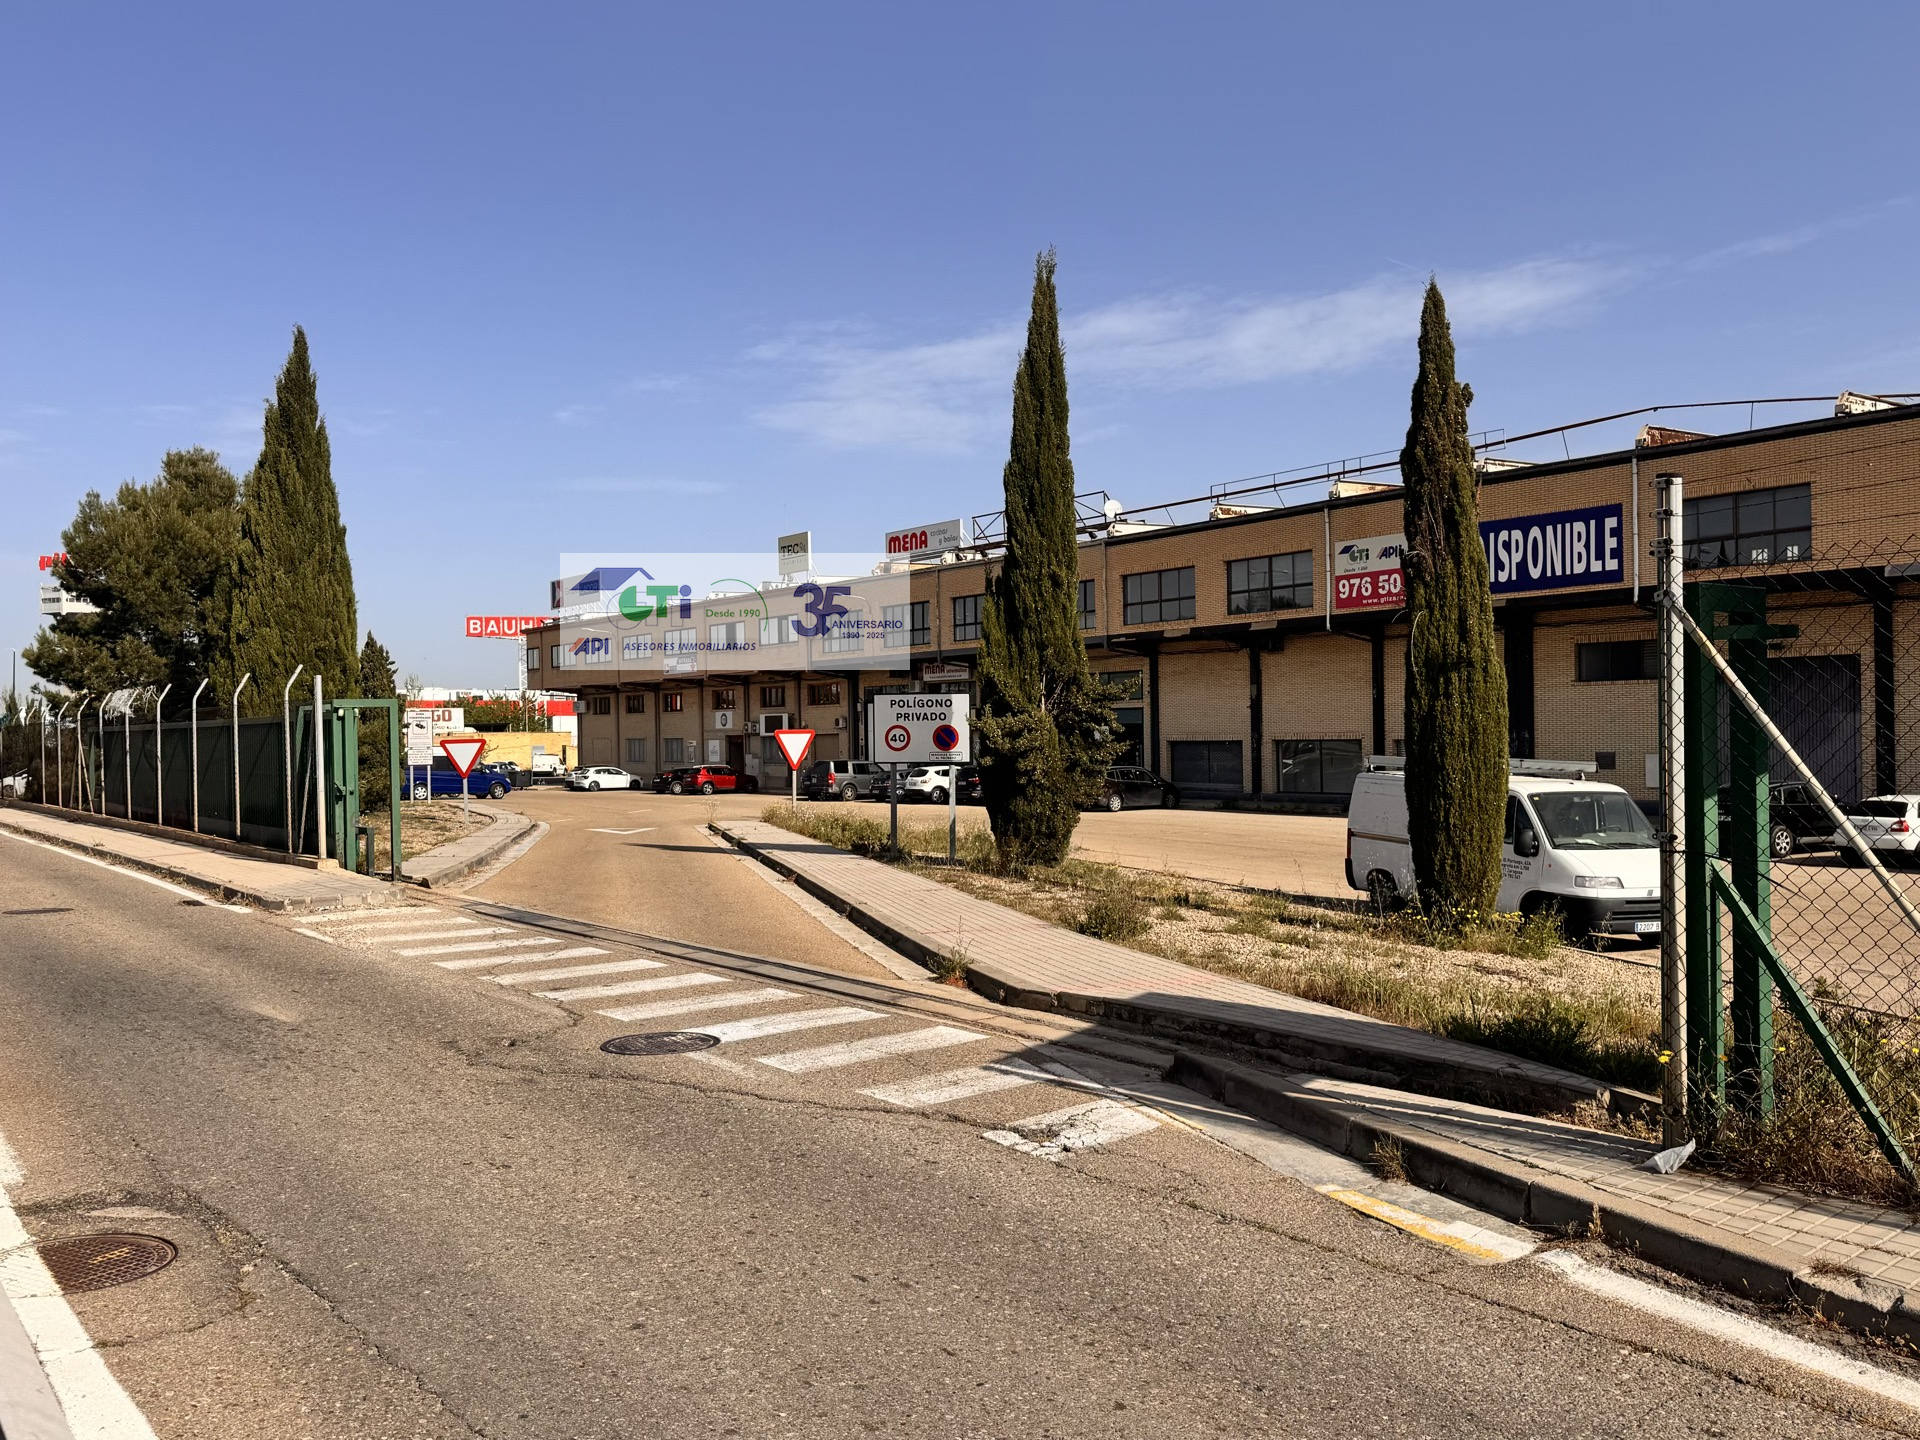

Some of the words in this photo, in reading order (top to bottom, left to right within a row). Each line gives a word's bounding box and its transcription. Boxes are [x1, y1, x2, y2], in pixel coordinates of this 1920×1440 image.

[888, 530, 928, 554] MENA
[1480, 516, 1619, 583] ISPONIBLE
[1338, 576, 1372, 599] 976
[1378, 573, 1401, 595] 50
[924, 664, 945, 675] MENA
[890, 696, 953, 708] POLÍGONO
[896, 712, 947, 721] PRIVADO
[889, 733, 906, 742] 40
[1639, 922, 1655, 931] 2207
